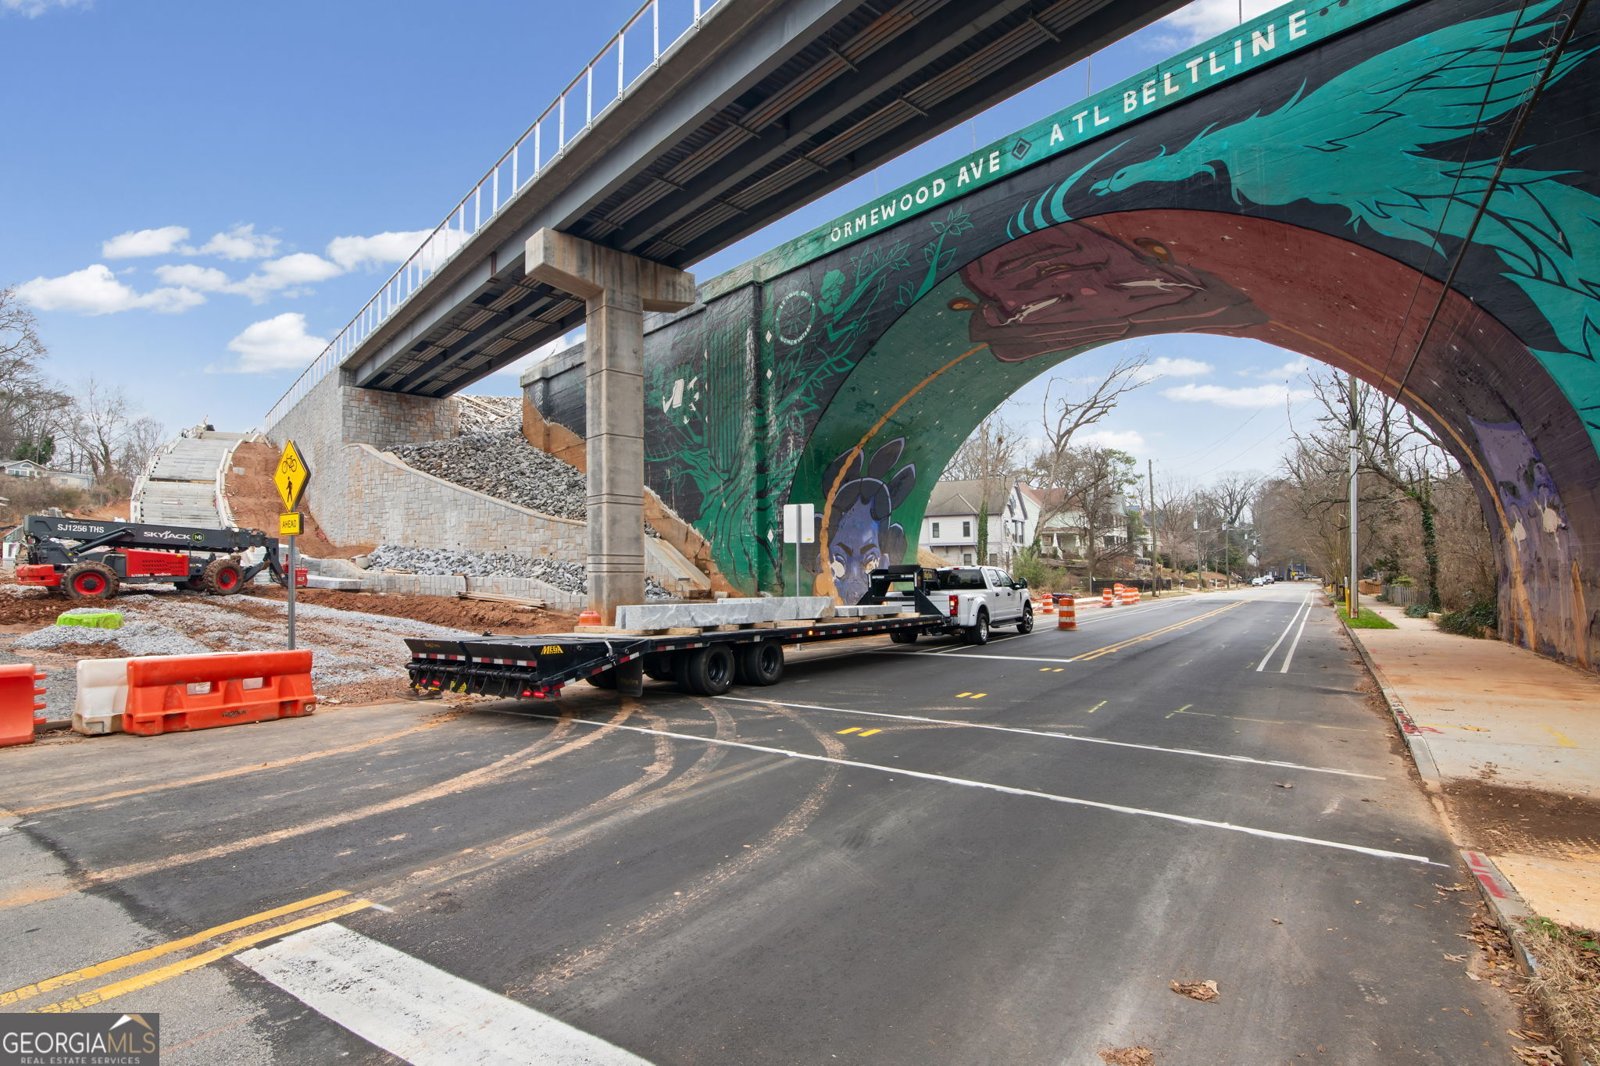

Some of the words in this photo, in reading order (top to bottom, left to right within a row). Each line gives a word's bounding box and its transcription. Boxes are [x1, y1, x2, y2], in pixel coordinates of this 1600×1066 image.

[830, 178, 946, 242] ORMEWOOD
[957, 150, 1000, 188] AVE
[1049, 105, 1110, 146] ATL
[1123, 9, 1307, 114] BELTLINE
[57, 523, 88, 533] SJ1256
[88, 525, 105, 534] THS
[282, 519, 297, 529] AHEAD
[143, 530, 191, 540] SKYJACK
[541, 645, 564, 655] MEGA
